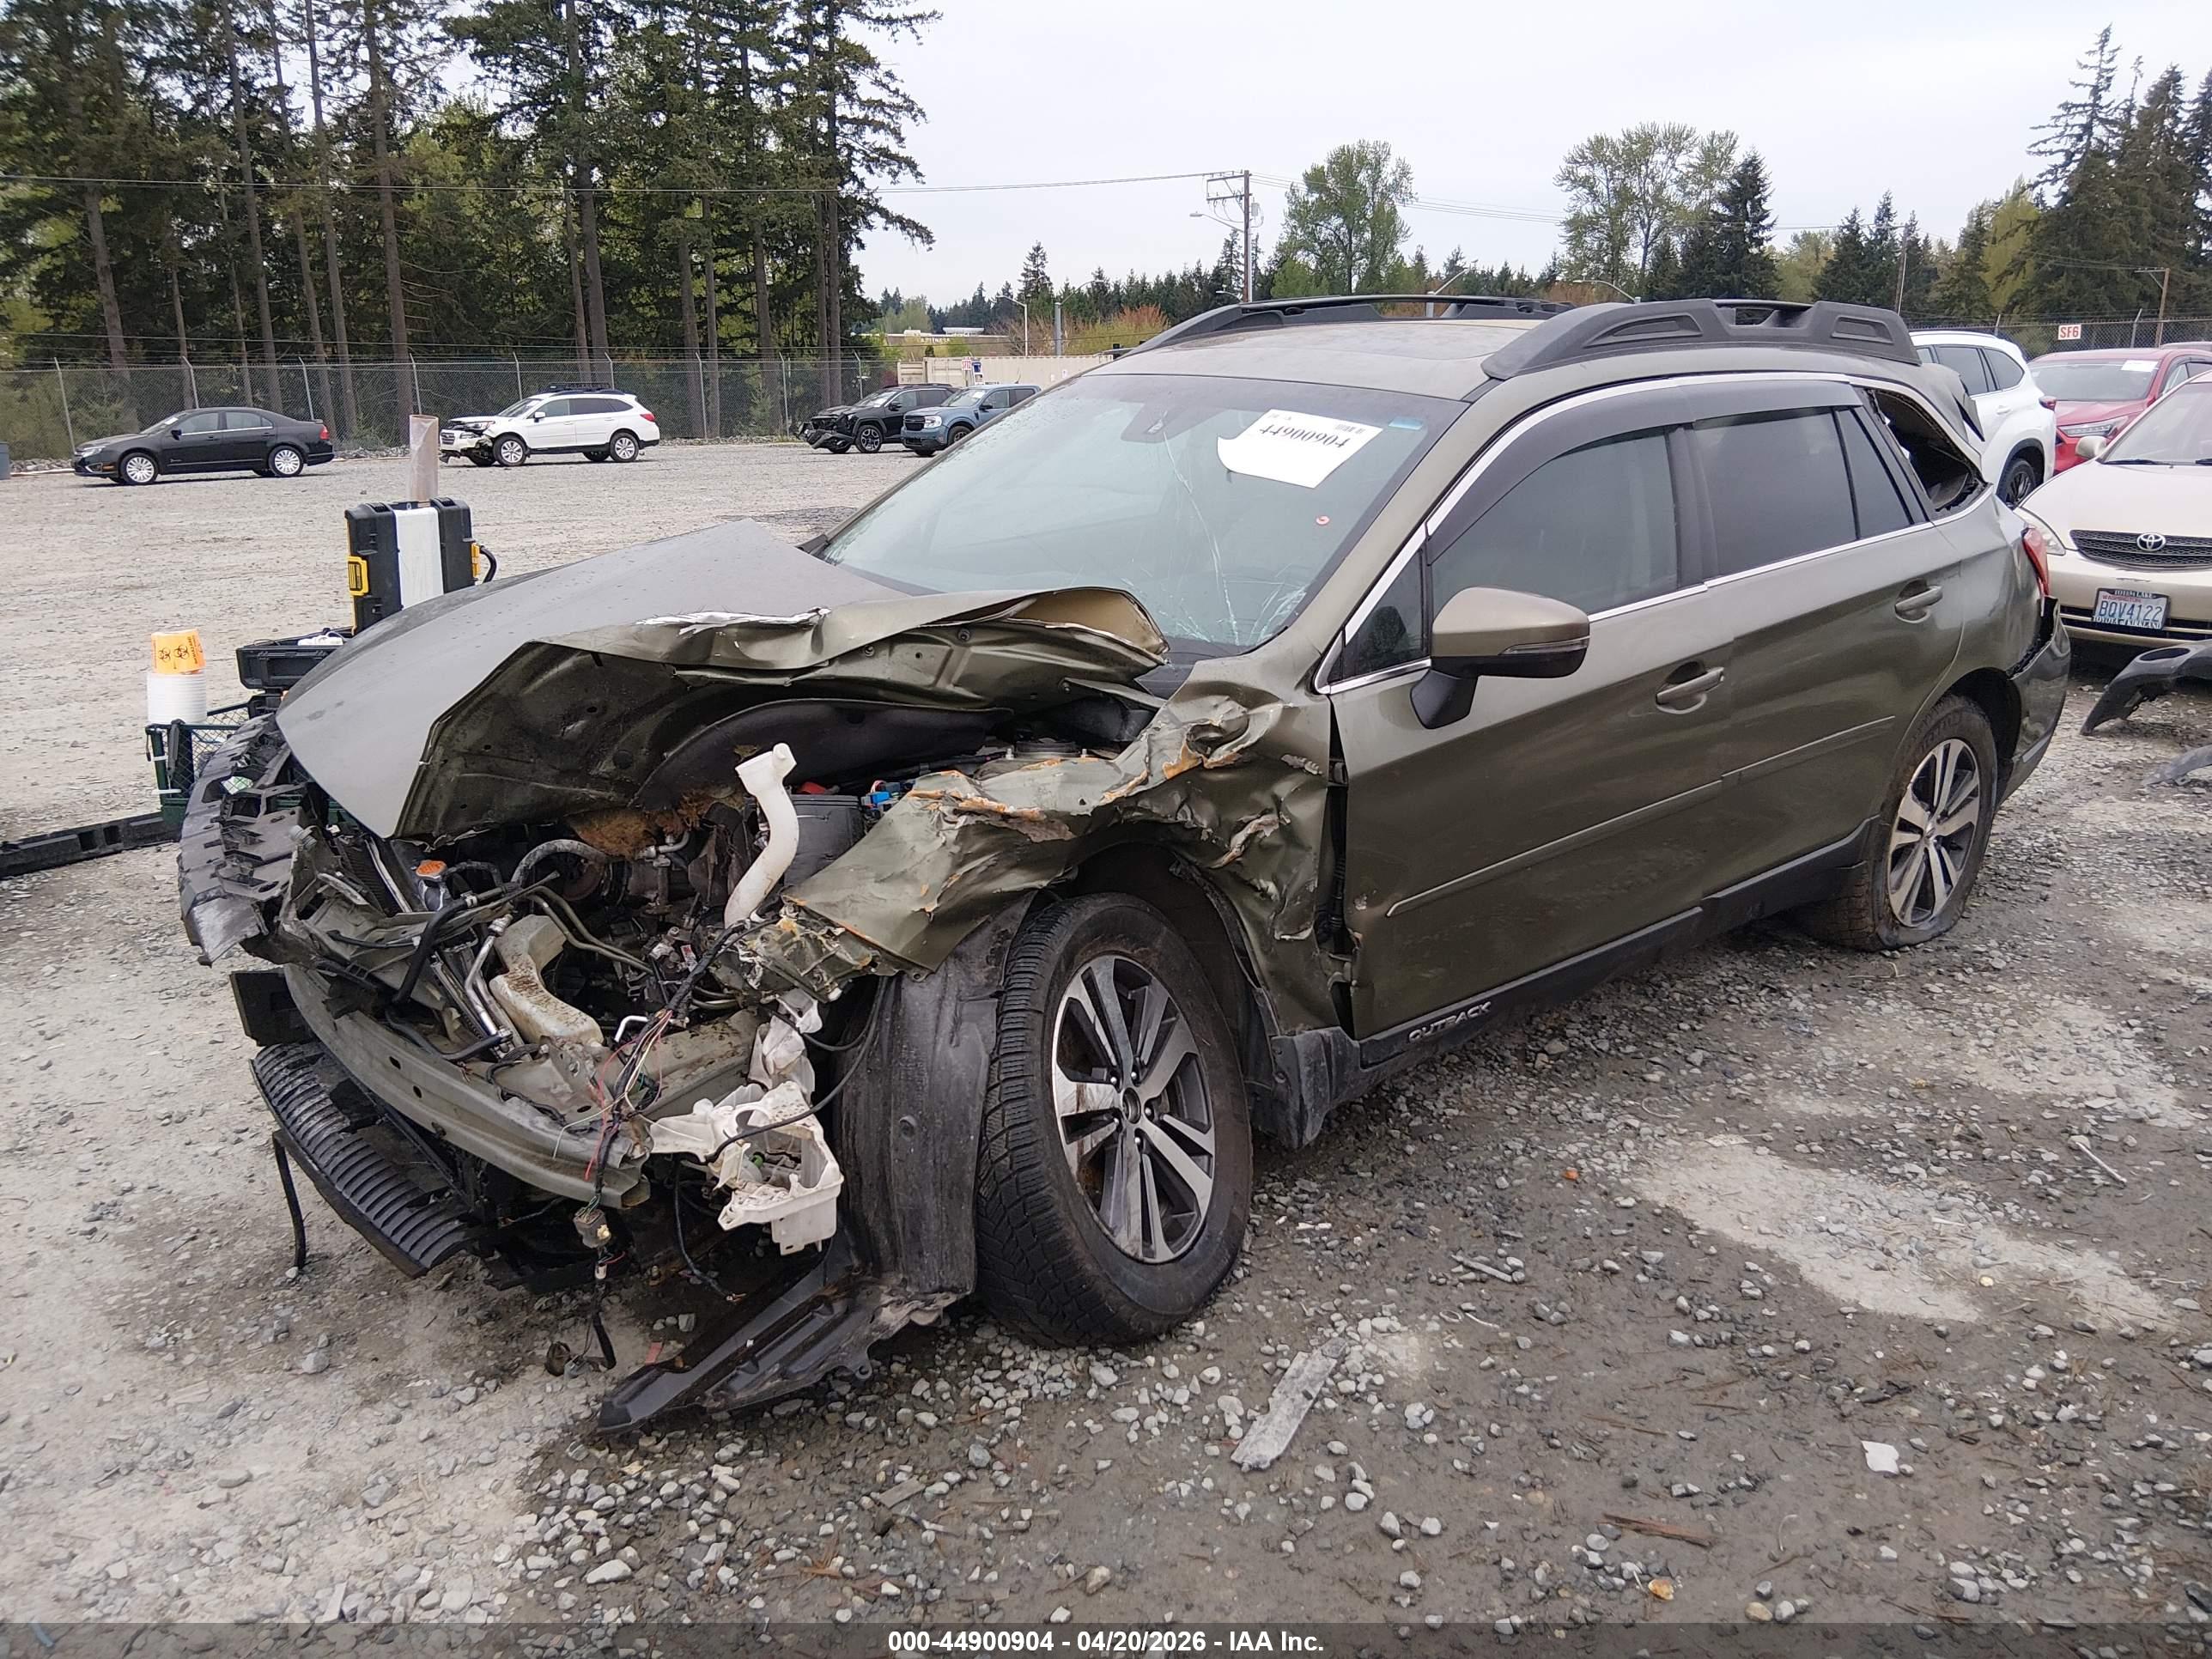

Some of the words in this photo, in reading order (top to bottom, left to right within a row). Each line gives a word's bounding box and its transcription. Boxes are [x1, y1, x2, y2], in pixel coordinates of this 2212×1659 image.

[2060, 326, 2079, 337] SF6
[1260, 424, 1351, 447] 44900904
[2102, 594, 2142, 603] WASHINGTON
[2099, 600, 2162, 622] BQV4122
[2093, 615, 2118, 624] TOYOTA
[2127, 620, 2161, 629] KIRKLAND
